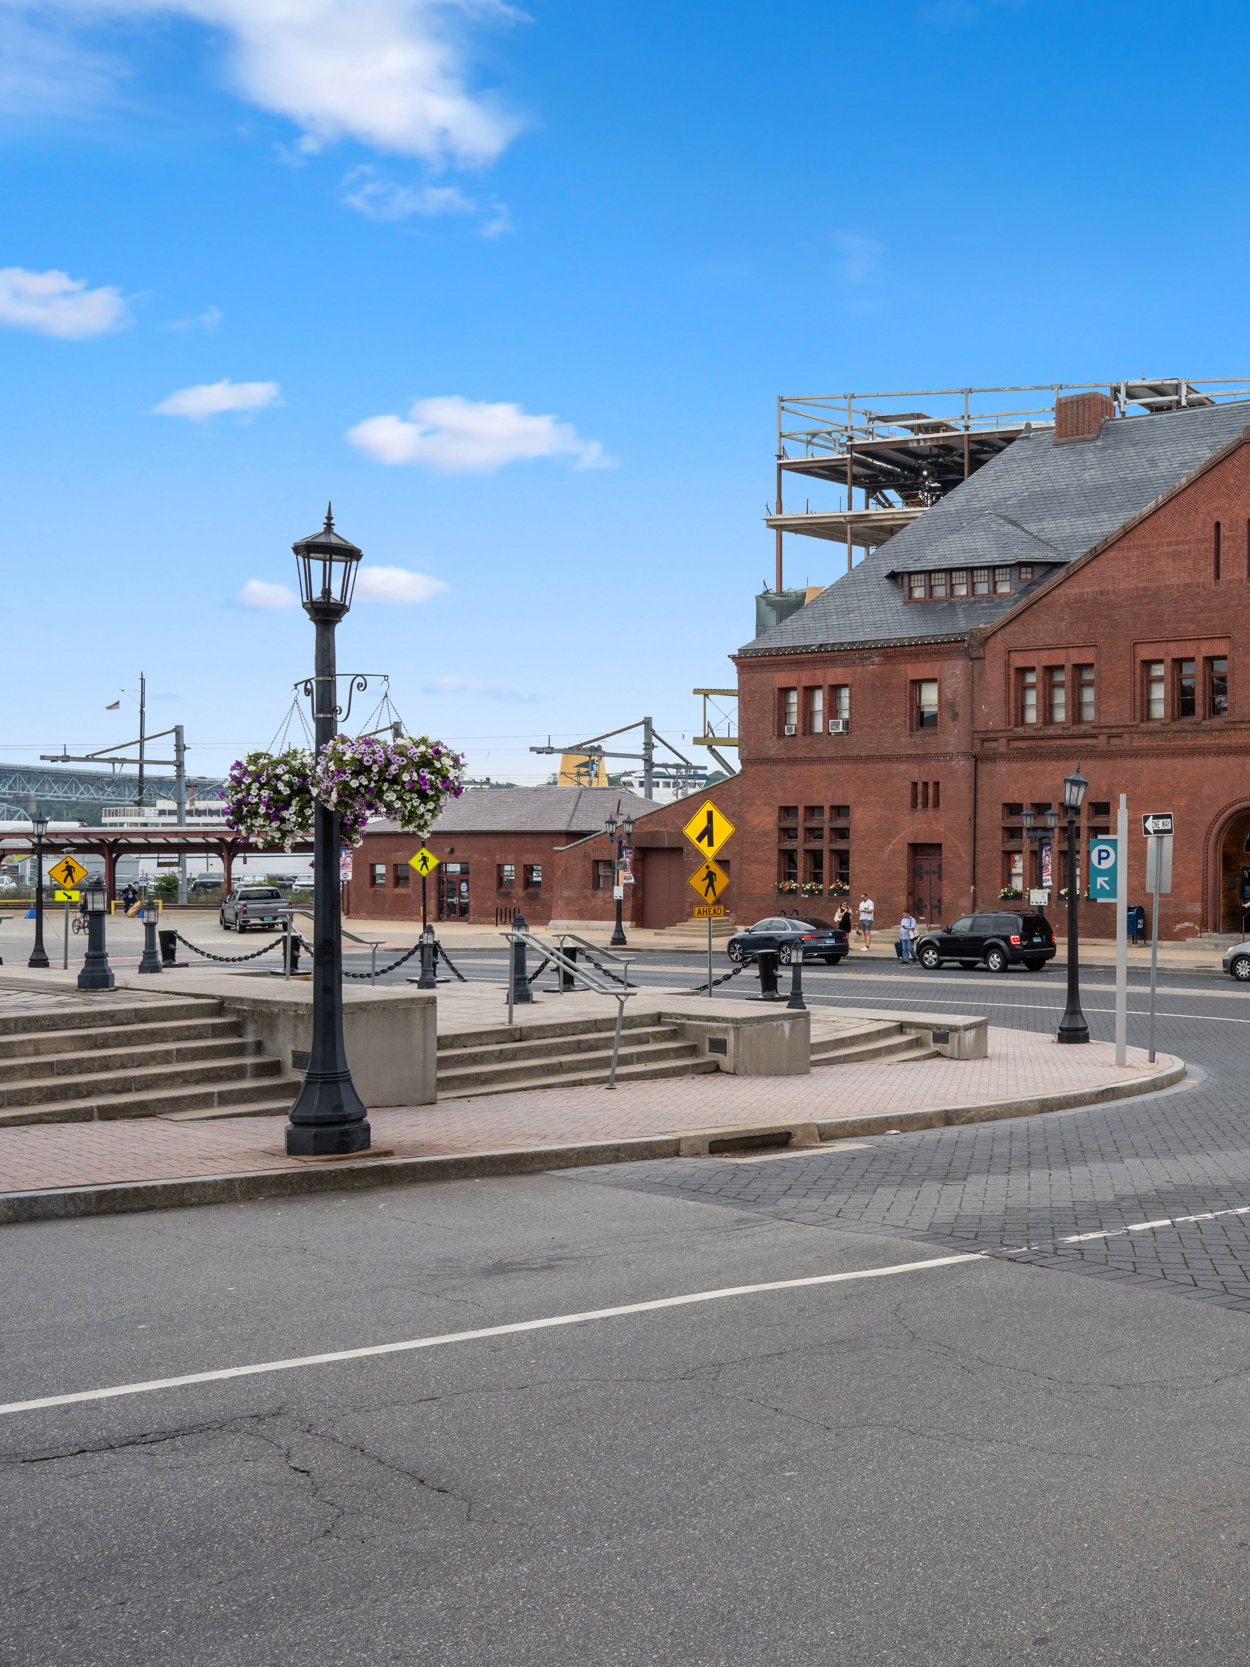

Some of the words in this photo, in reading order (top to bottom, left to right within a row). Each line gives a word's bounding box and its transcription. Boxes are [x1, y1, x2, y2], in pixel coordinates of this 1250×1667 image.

[1152, 820, 1161, 828] ONE
[1162, 820, 1171, 828] WAY
[1097, 849, 1111, 866] P
[696, 907, 722, 916] AHEAD
